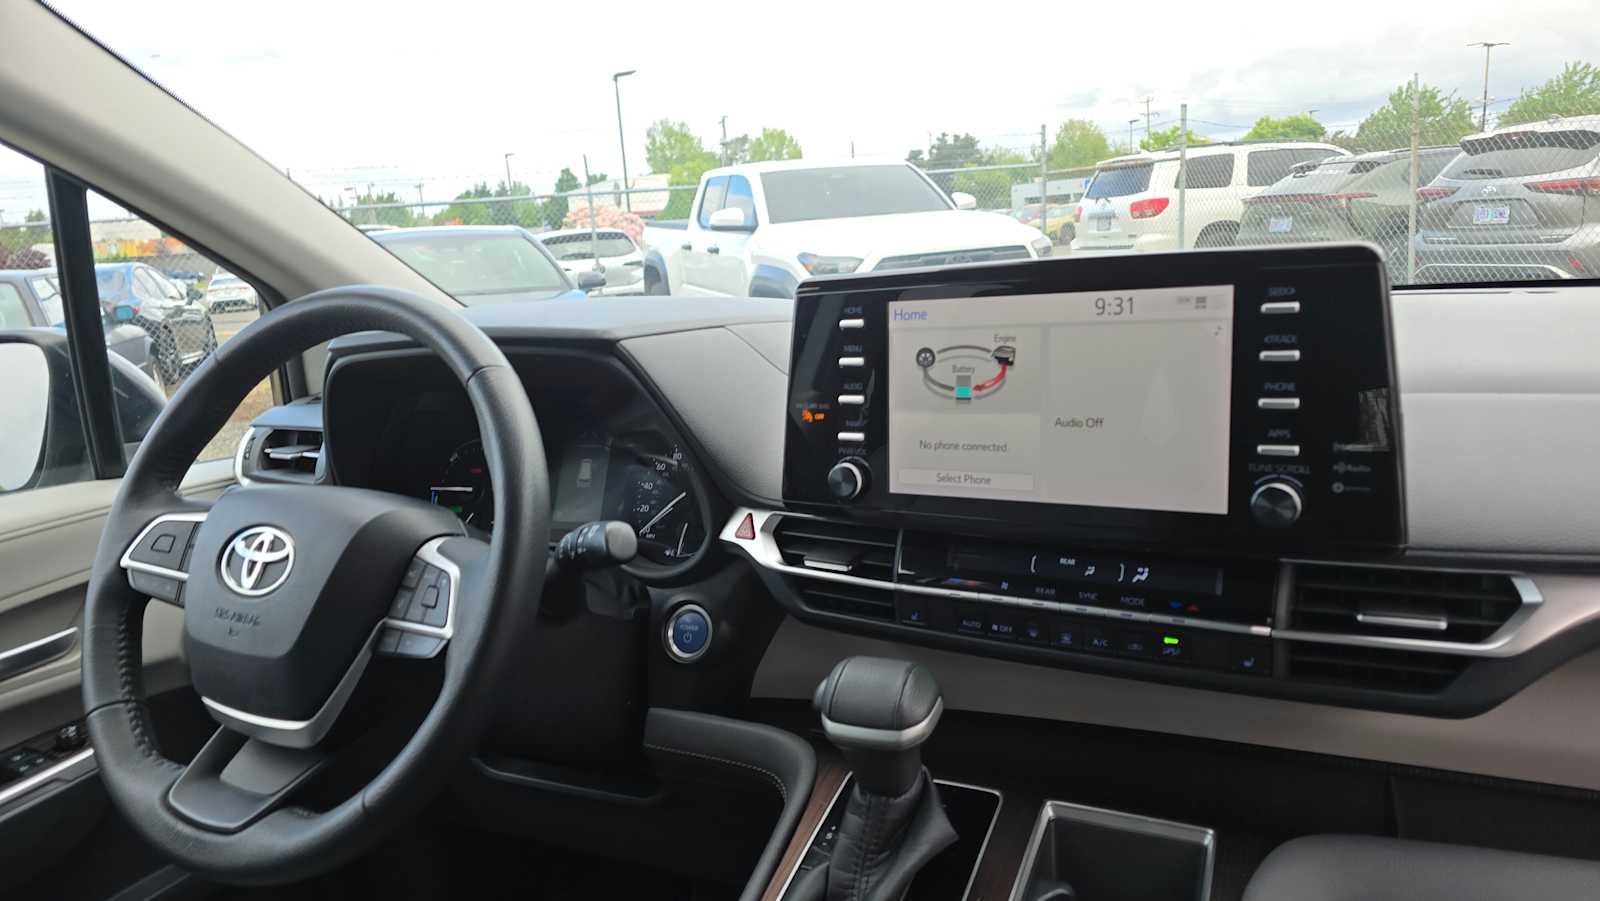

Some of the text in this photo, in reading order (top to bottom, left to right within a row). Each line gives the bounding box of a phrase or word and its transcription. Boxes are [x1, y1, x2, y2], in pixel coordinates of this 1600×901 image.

[1095, 297, 1134, 316] 9:31
[893, 308, 928, 321] Home
[993, 334, 1017, 344] Engine
[952, 364, 975, 374] Battery
[1054, 416, 1105, 429] Audio Off
[919, 439, 1008, 453] No phone connected
[656, 462, 667, 471] 60
[936, 473, 992, 486] Select Phone
[643, 482, 654, 491] 40
[640, 503, 650, 513] 20
[1034, 586, 1056, 597] REAR
[1091, 638, 1110, 649] A/C
